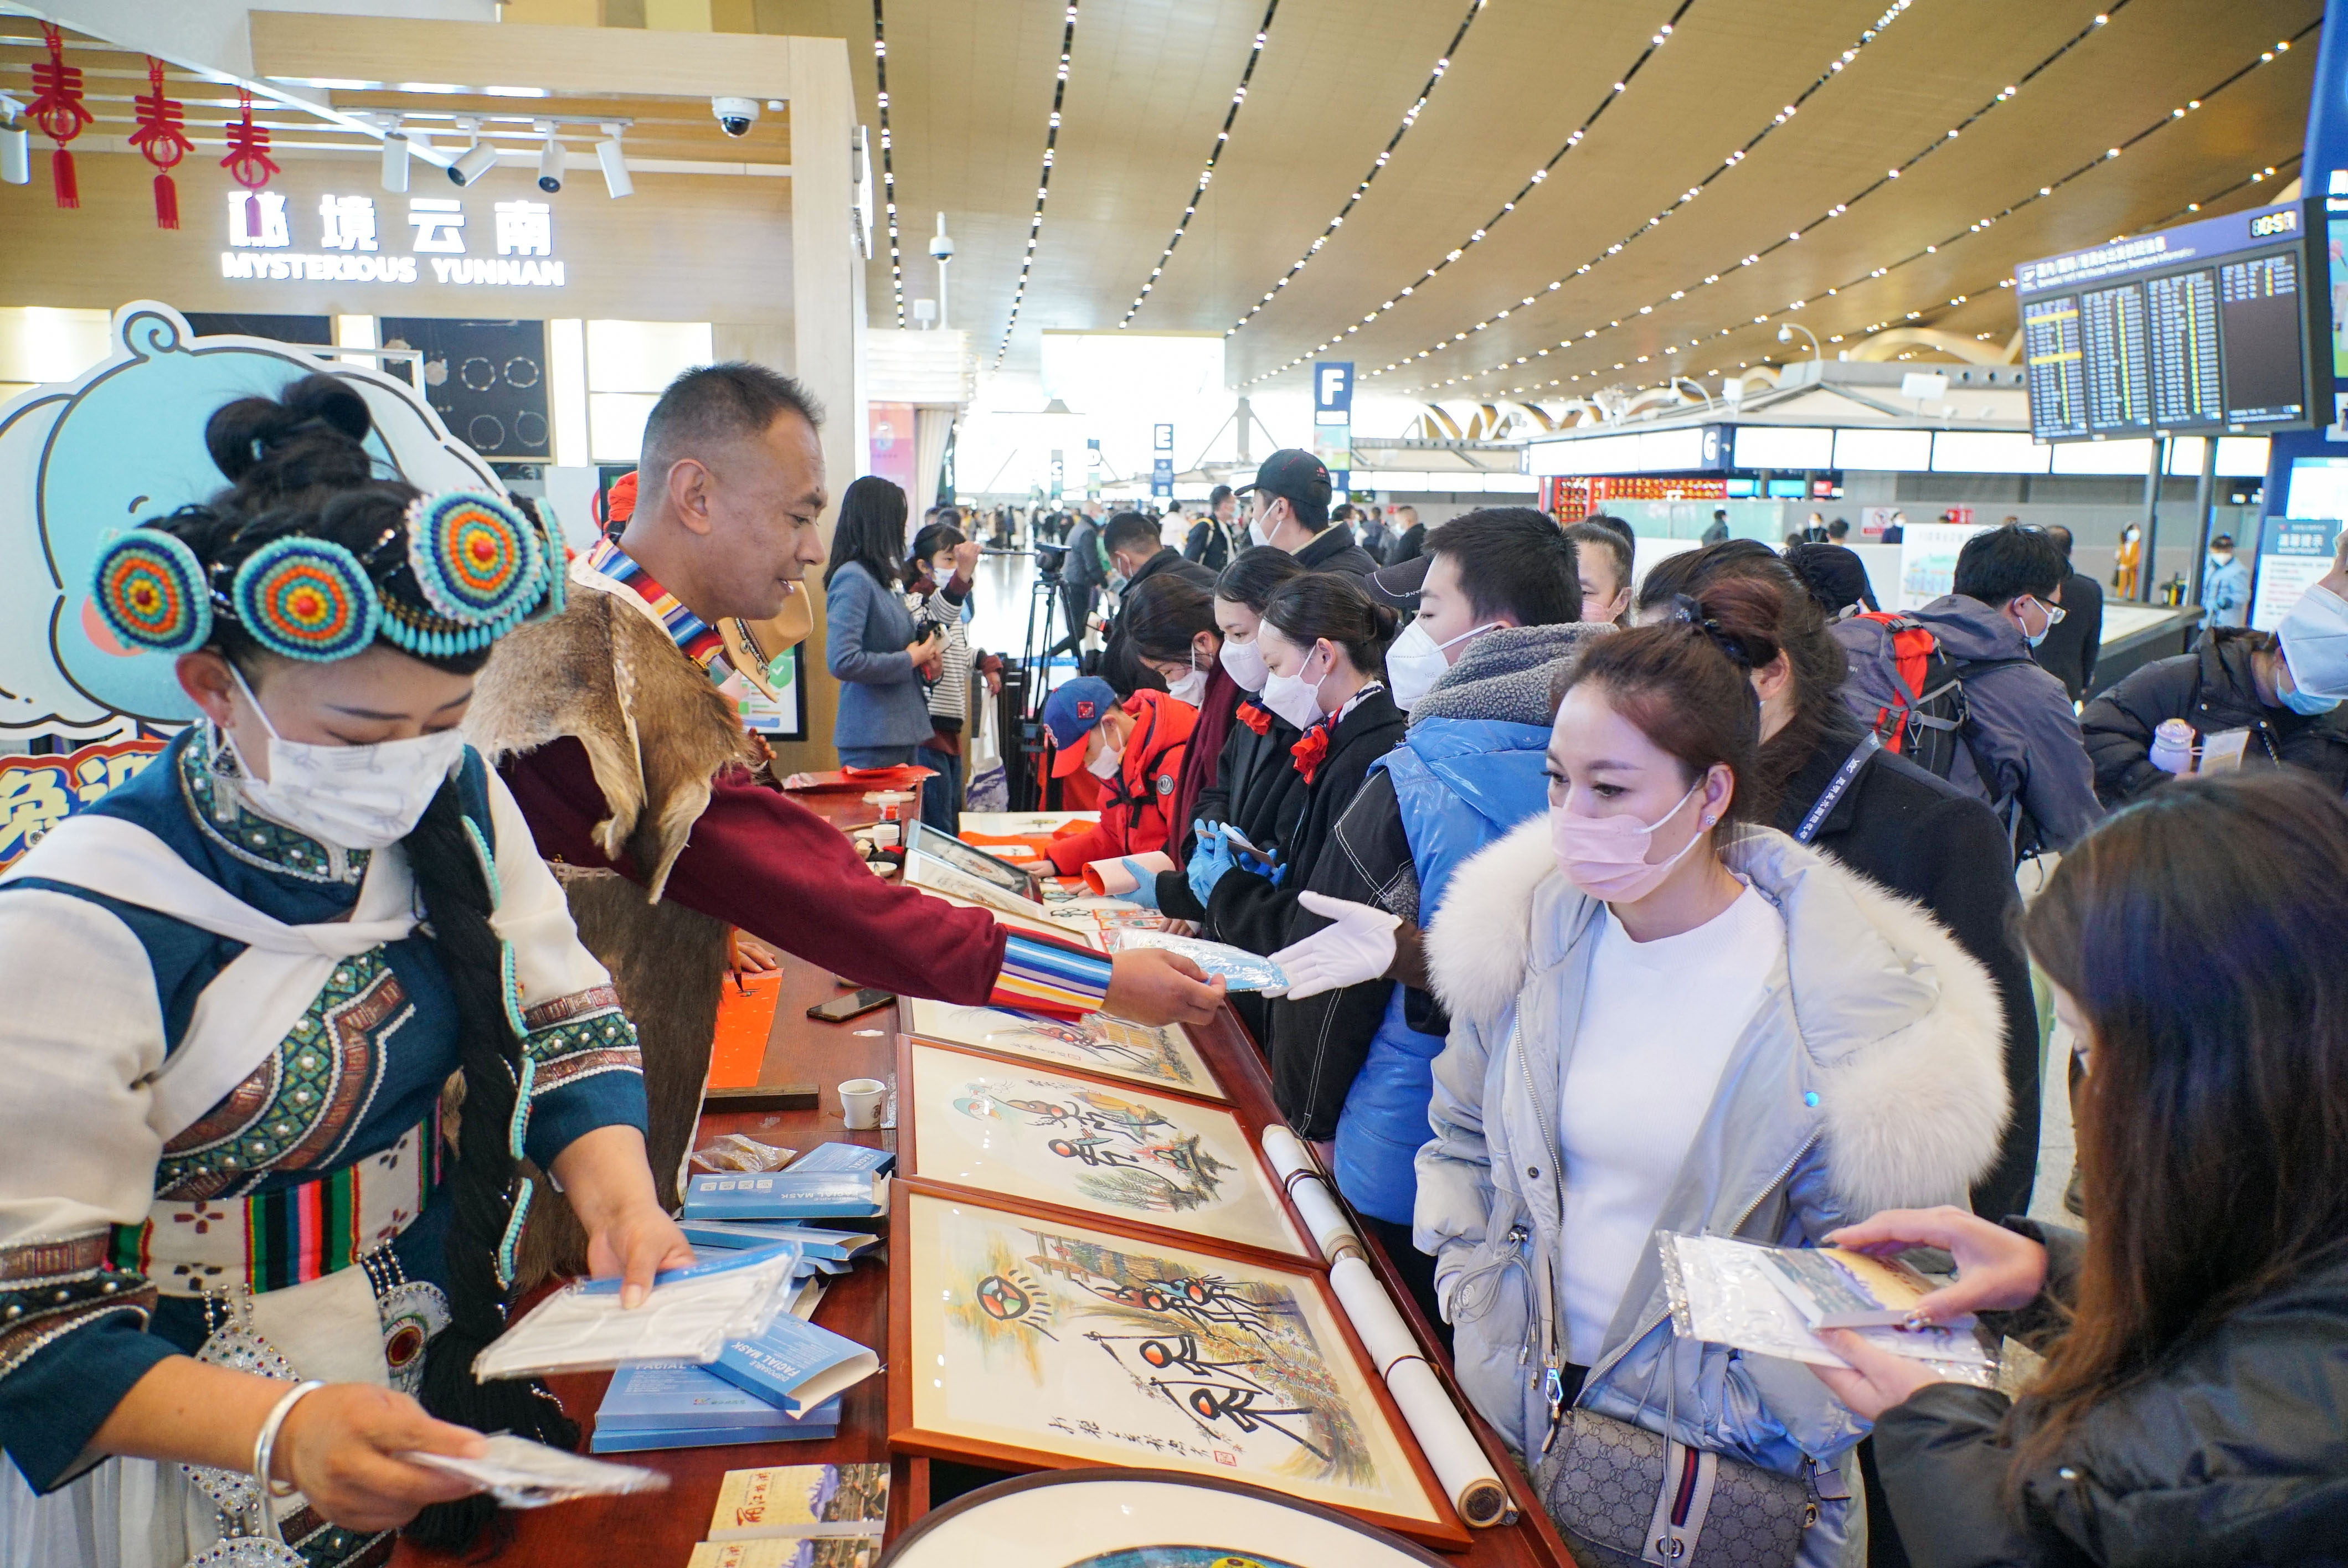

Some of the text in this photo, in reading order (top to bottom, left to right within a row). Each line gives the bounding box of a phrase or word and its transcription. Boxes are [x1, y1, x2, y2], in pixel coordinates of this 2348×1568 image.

[222, 252, 565, 287] MYSTERIOUS YUNNAN
[1321, 369, 1345, 405] F
[1156, 425, 1171, 448] E
[1799, 777, 1847, 840] 昆明长水国际机场
[731, 1342, 765, 1359] MASK
[749, 1359, 790, 1383] DISPOSABLE
[762, 1354, 801, 1378] FACIAL
